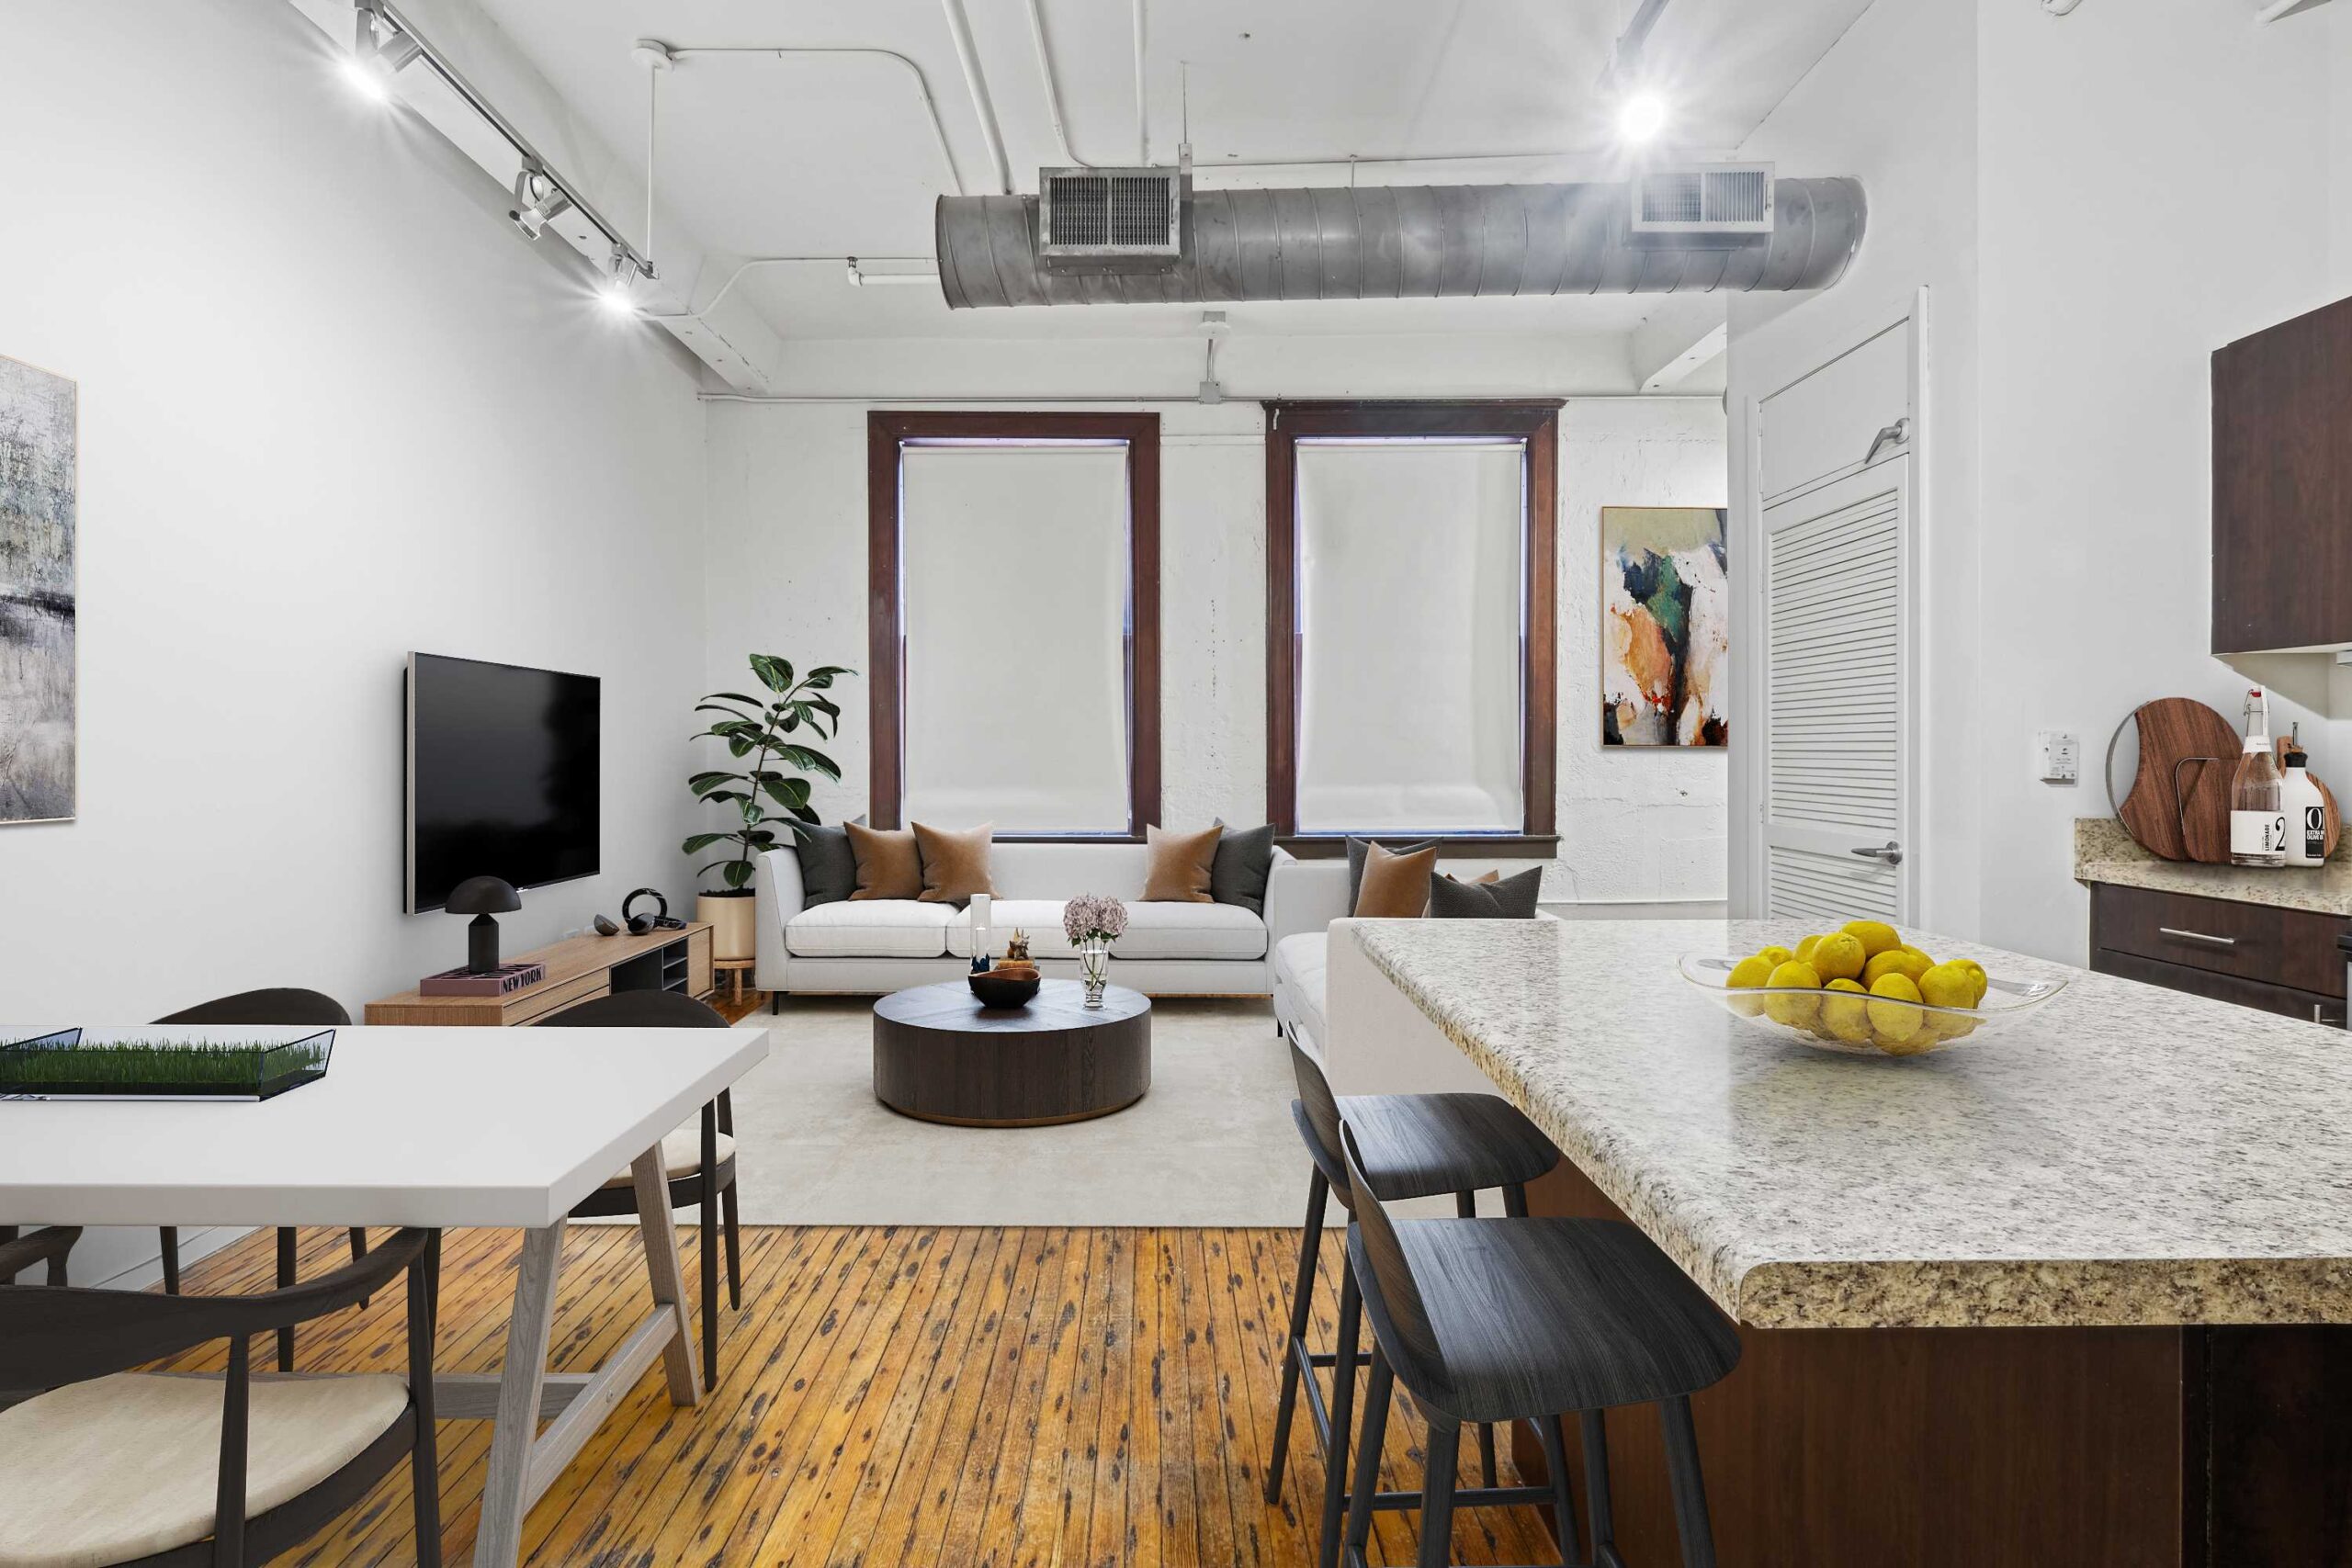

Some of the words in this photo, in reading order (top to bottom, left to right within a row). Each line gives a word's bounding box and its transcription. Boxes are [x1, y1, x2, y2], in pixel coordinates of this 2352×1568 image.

[2275, 817, 2285, 851] 2
[503, 975, 519, 992] NEW
[520, 967, 541, 987] YORK
